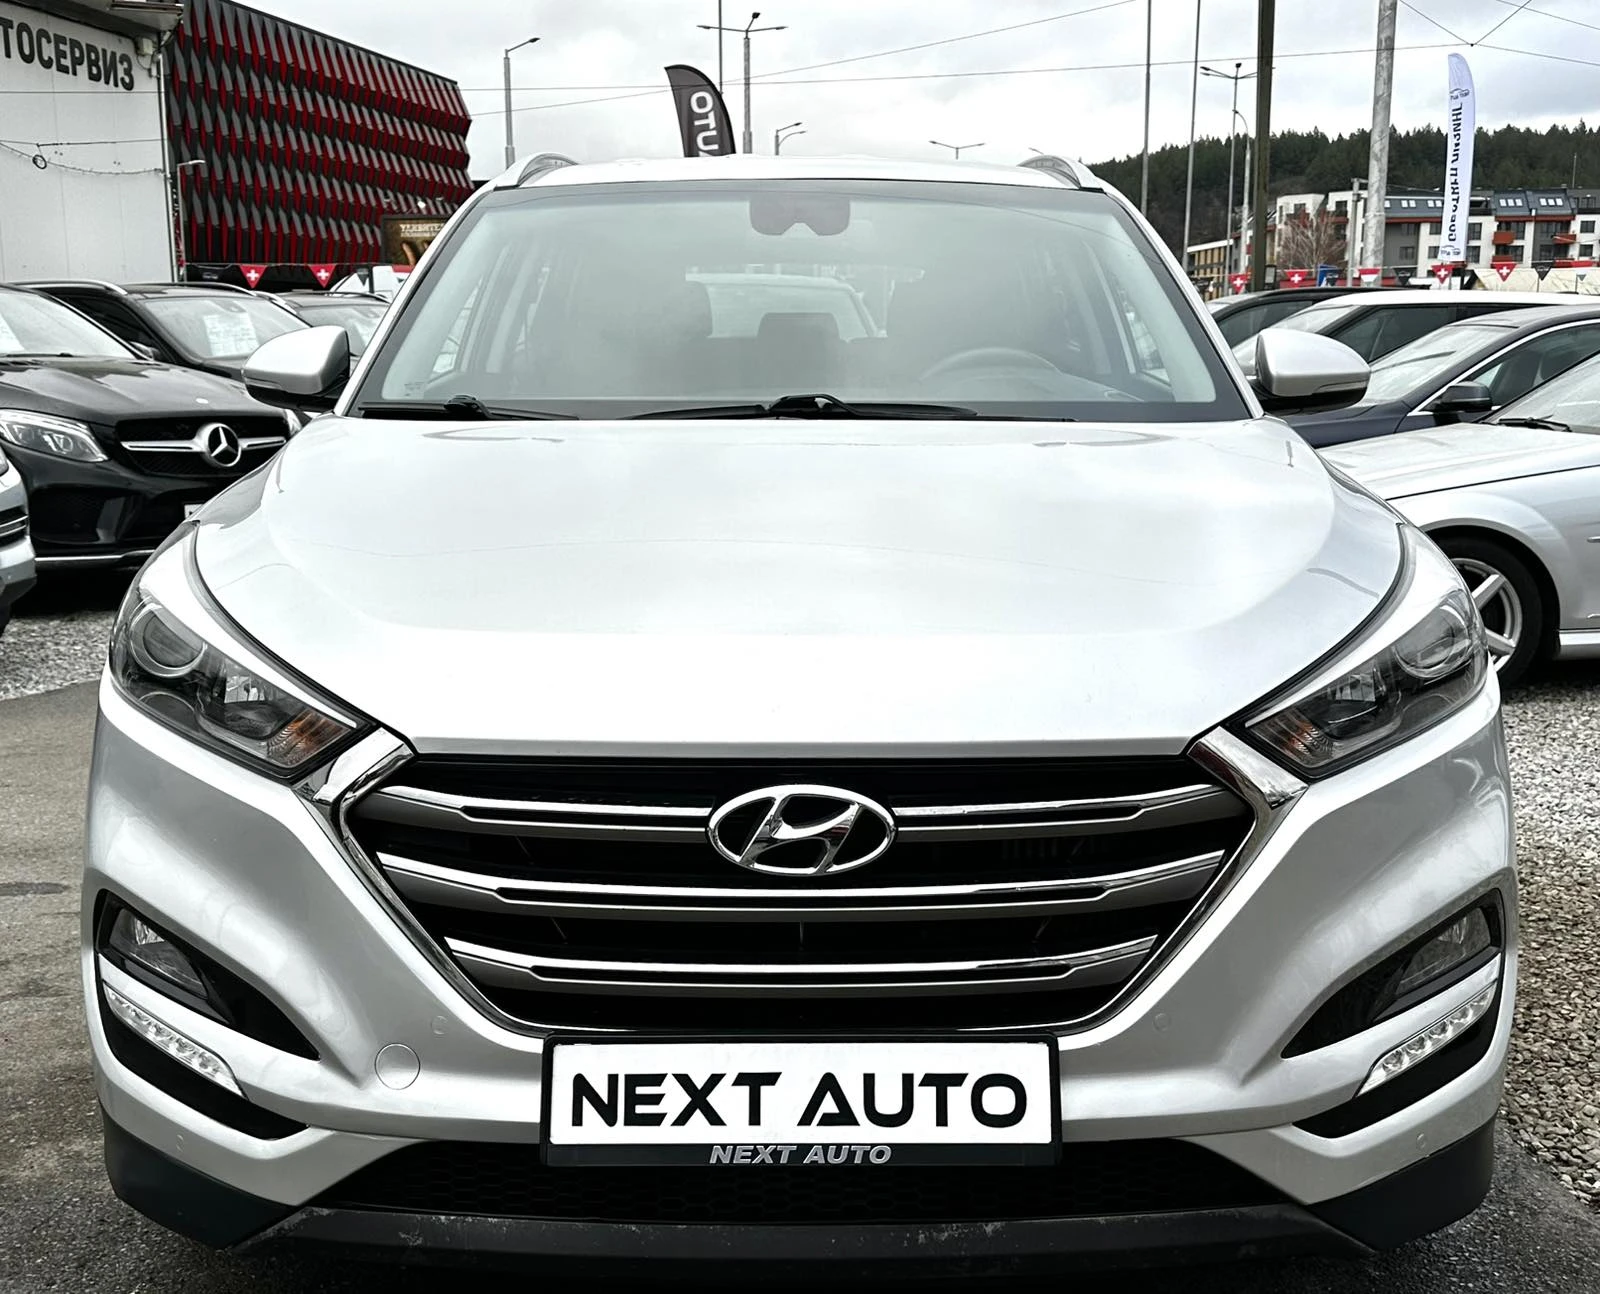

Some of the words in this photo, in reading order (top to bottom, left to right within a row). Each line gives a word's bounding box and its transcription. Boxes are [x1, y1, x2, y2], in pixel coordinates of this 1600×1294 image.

[0, 16, 134, 91] ТОСЕРВИЗ
[571, 1071, 783, 1128] NEXT
[796, 1071, 1028, 1129] AUTO
[708, 1145, 801, 1165] NEXT
[802, 1145, 892, 1165] AUTO
